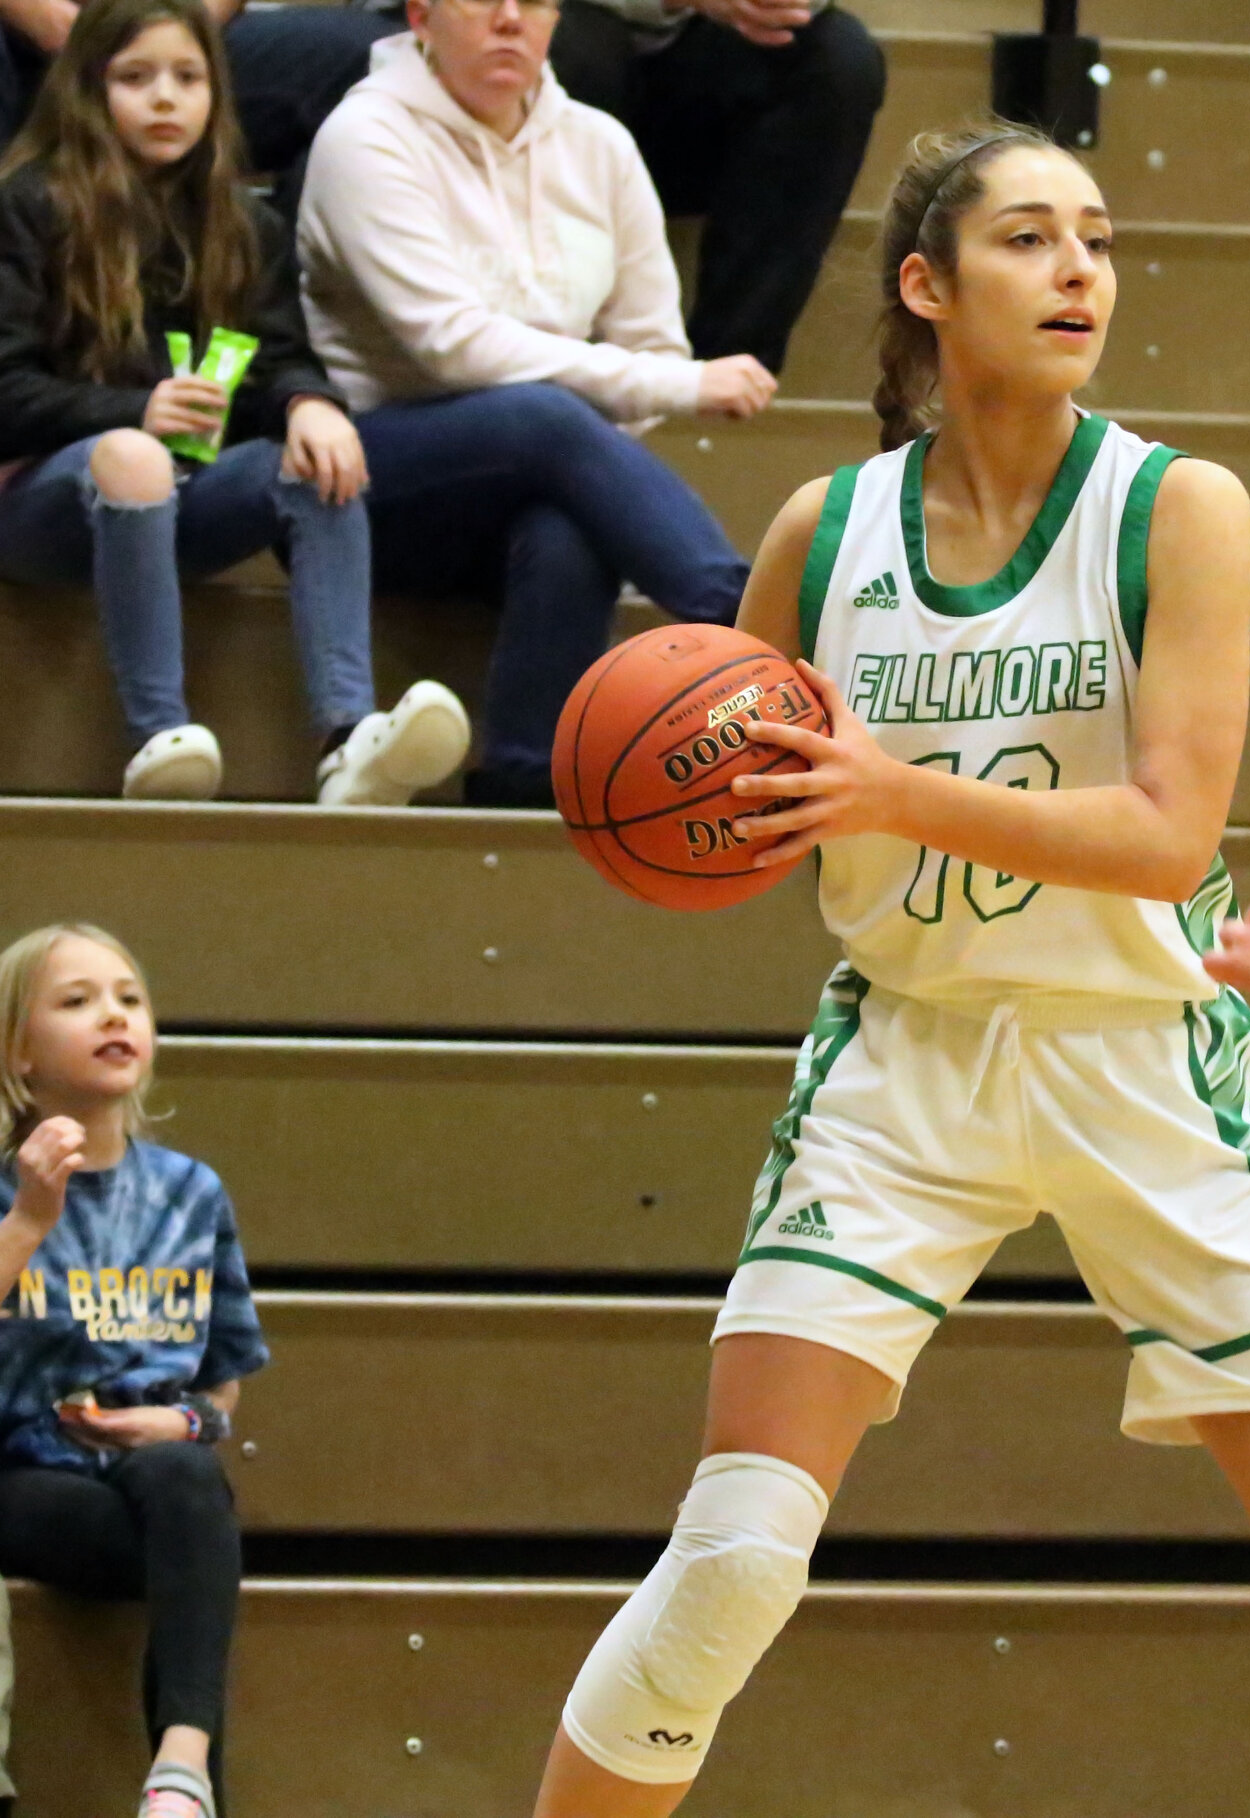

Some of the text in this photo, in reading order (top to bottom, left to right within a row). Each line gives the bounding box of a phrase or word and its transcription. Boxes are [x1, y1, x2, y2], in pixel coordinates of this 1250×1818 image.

[853, 593, 900, 610] adida
[847, 640, 1106, 723] FILLMORE
[778, 1221, 835, 1241] adidas
